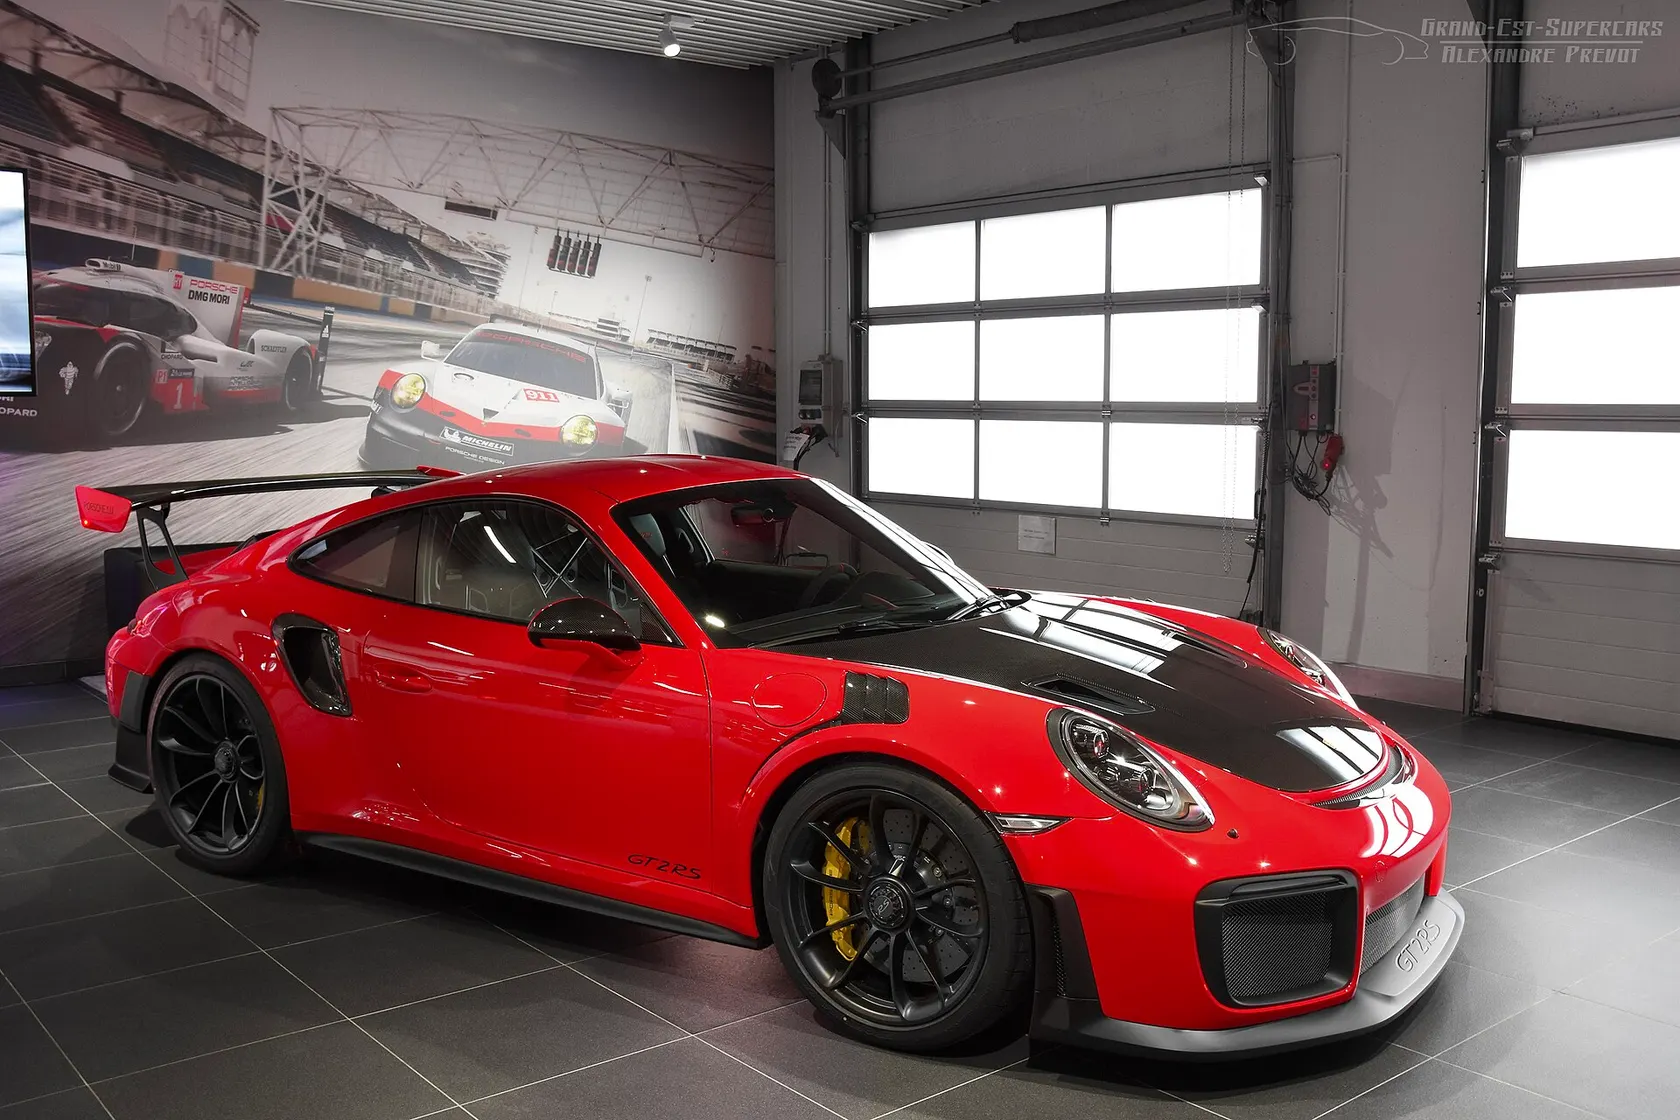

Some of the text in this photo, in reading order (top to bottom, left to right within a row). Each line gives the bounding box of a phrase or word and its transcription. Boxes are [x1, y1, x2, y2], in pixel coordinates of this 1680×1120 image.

[189, 279, 239, 295] PORSCHE
[188, 290, 231, 305] DMG MORI
[475, 331, 585, 363] PORSCHE
[173, 382, 184, 410] 1
[525, 389, 557, 401] 911
[461, 435, 512, 452] MICHELIN
[445, 446, 478, 459] PORSCHE
[478, 455, 505, 465] DESIGN
